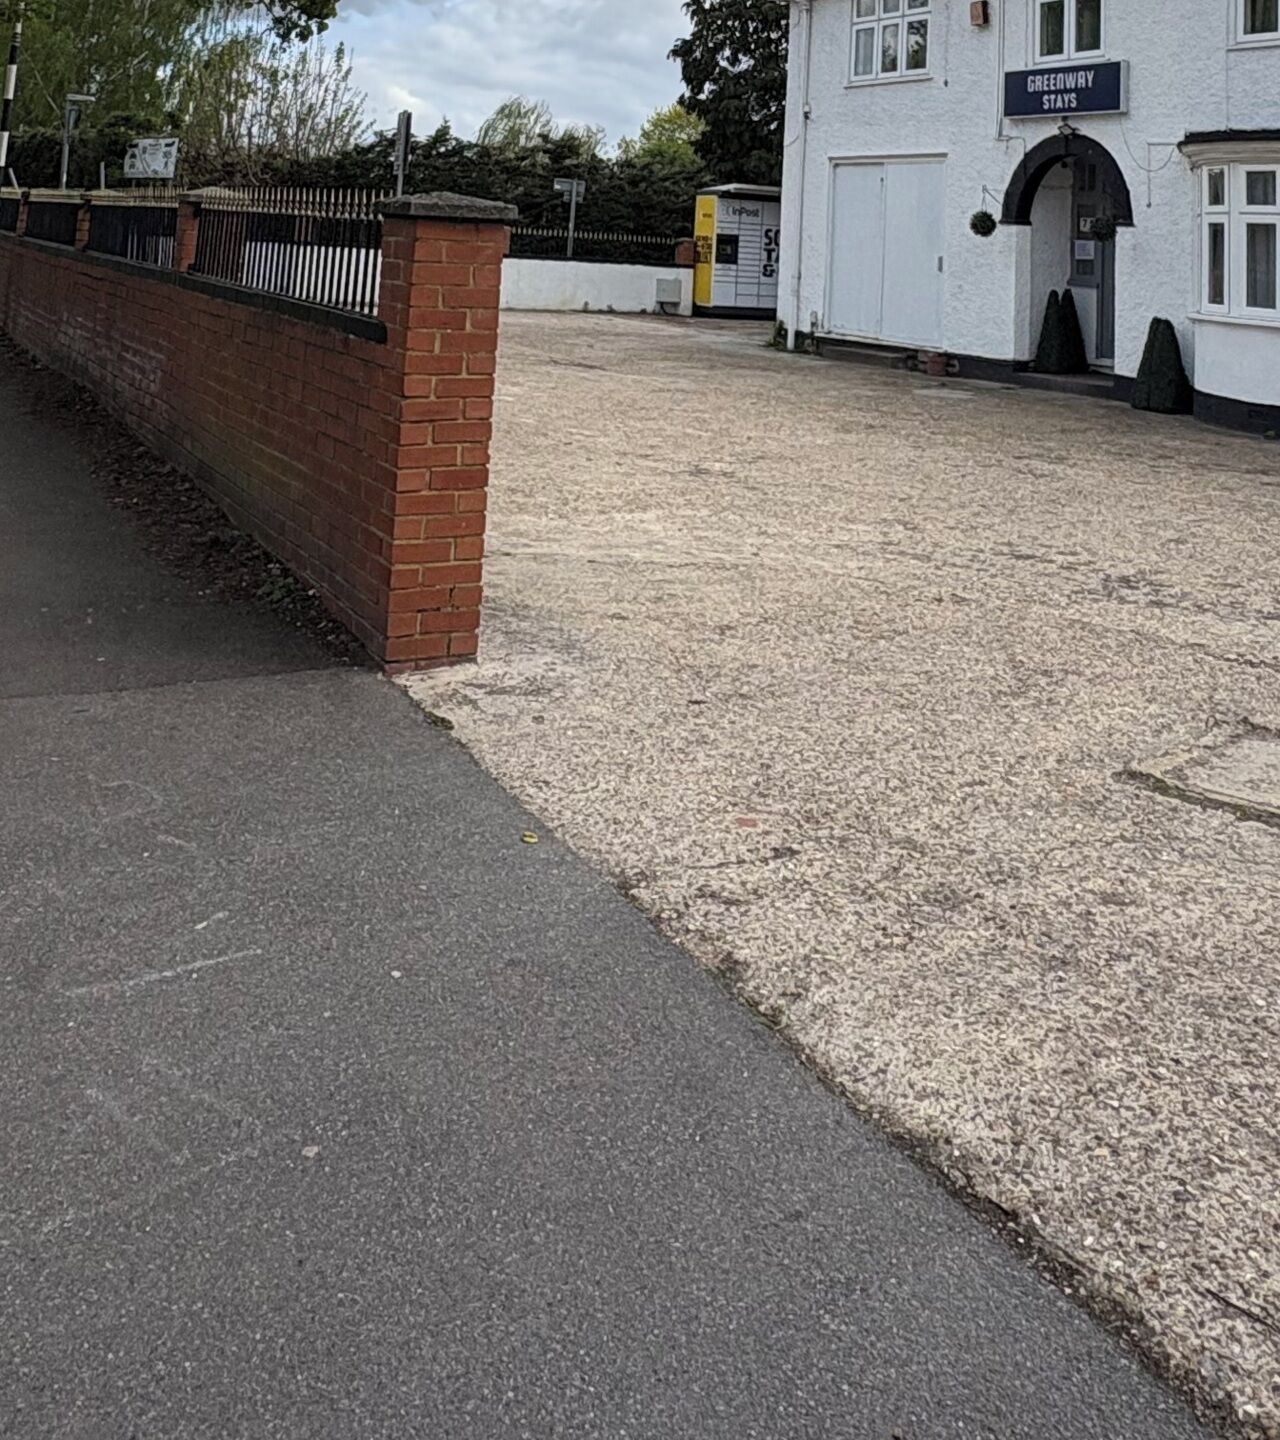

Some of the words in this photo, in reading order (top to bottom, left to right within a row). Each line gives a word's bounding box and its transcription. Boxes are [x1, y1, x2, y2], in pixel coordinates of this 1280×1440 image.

[1027, 70, 1095, 93] GREENWAY
[1042, 92, 1077, 110] STAYS
[731, 205, 760, 218] InPost
